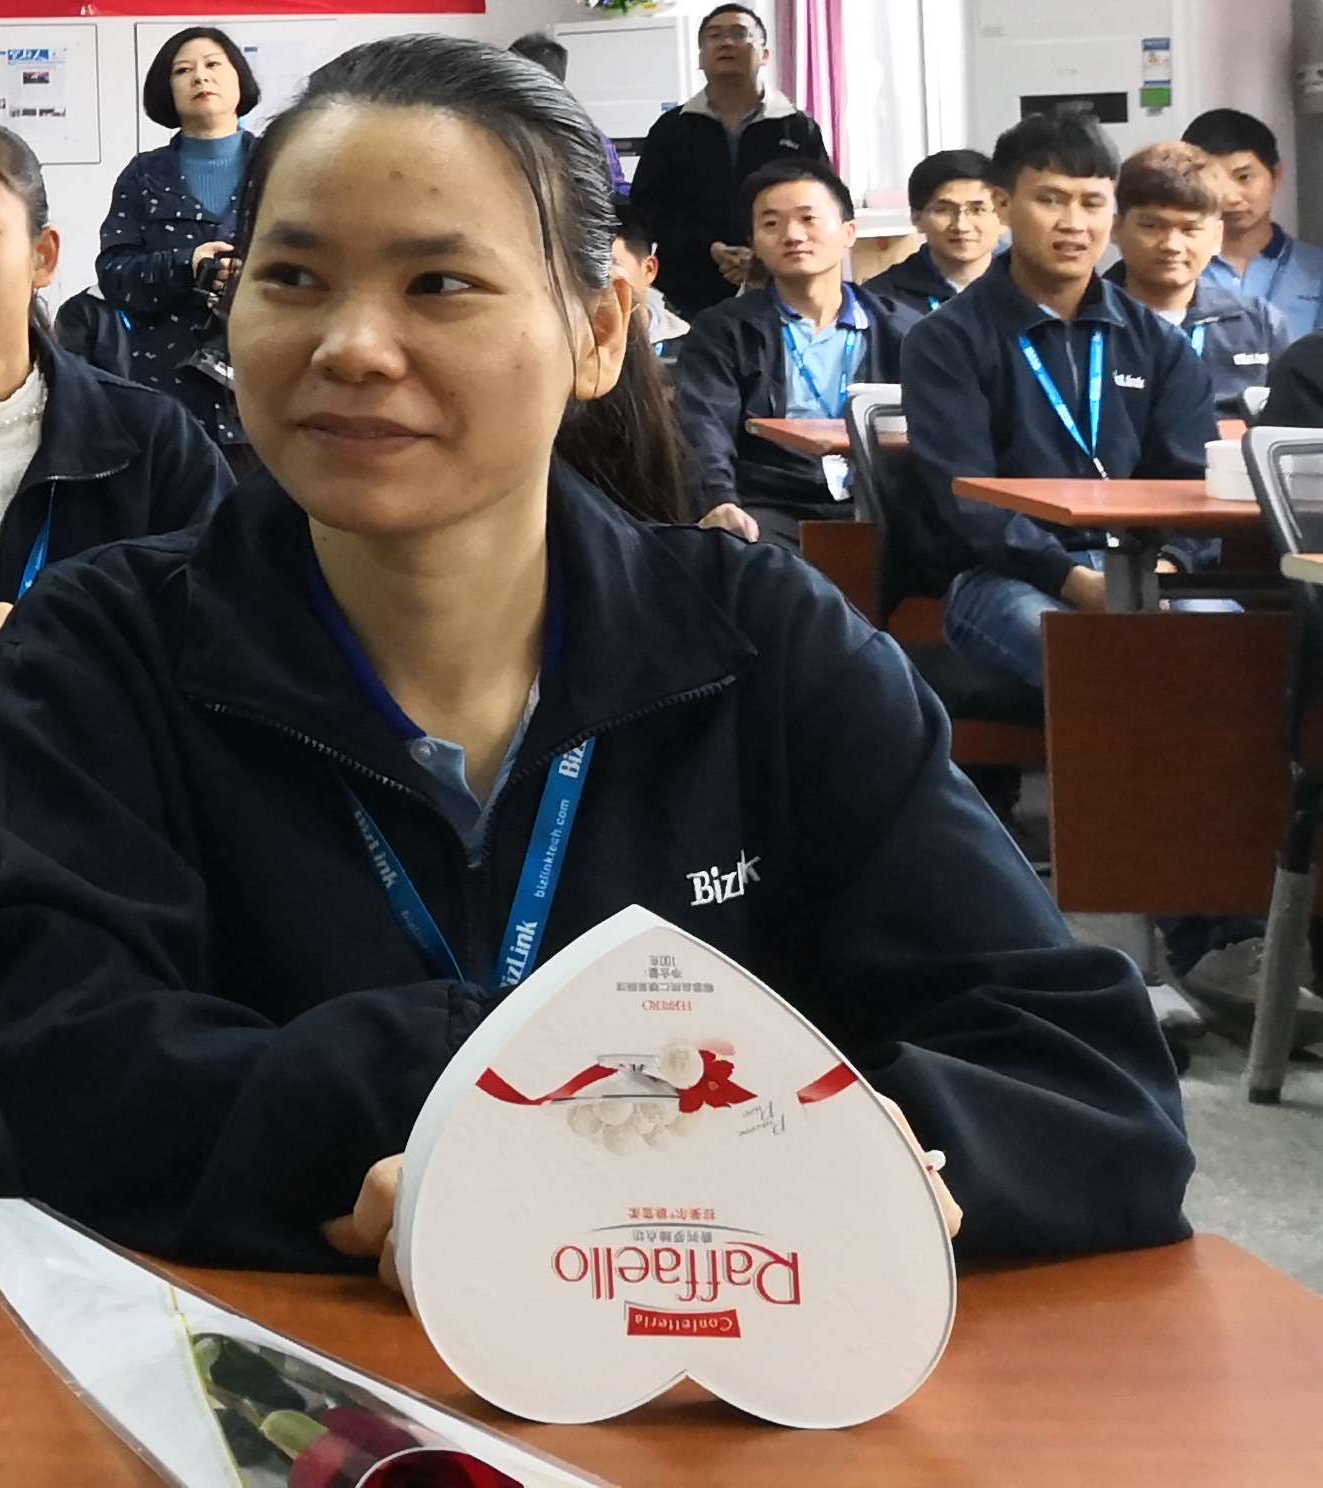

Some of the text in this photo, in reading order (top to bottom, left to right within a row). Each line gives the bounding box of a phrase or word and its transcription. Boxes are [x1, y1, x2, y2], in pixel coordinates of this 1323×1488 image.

[498, 920, 539, 988] izLink
[552, 1240, 802, 1306] Raffaello
[633, 1312, 734, 1333] Confetteria
